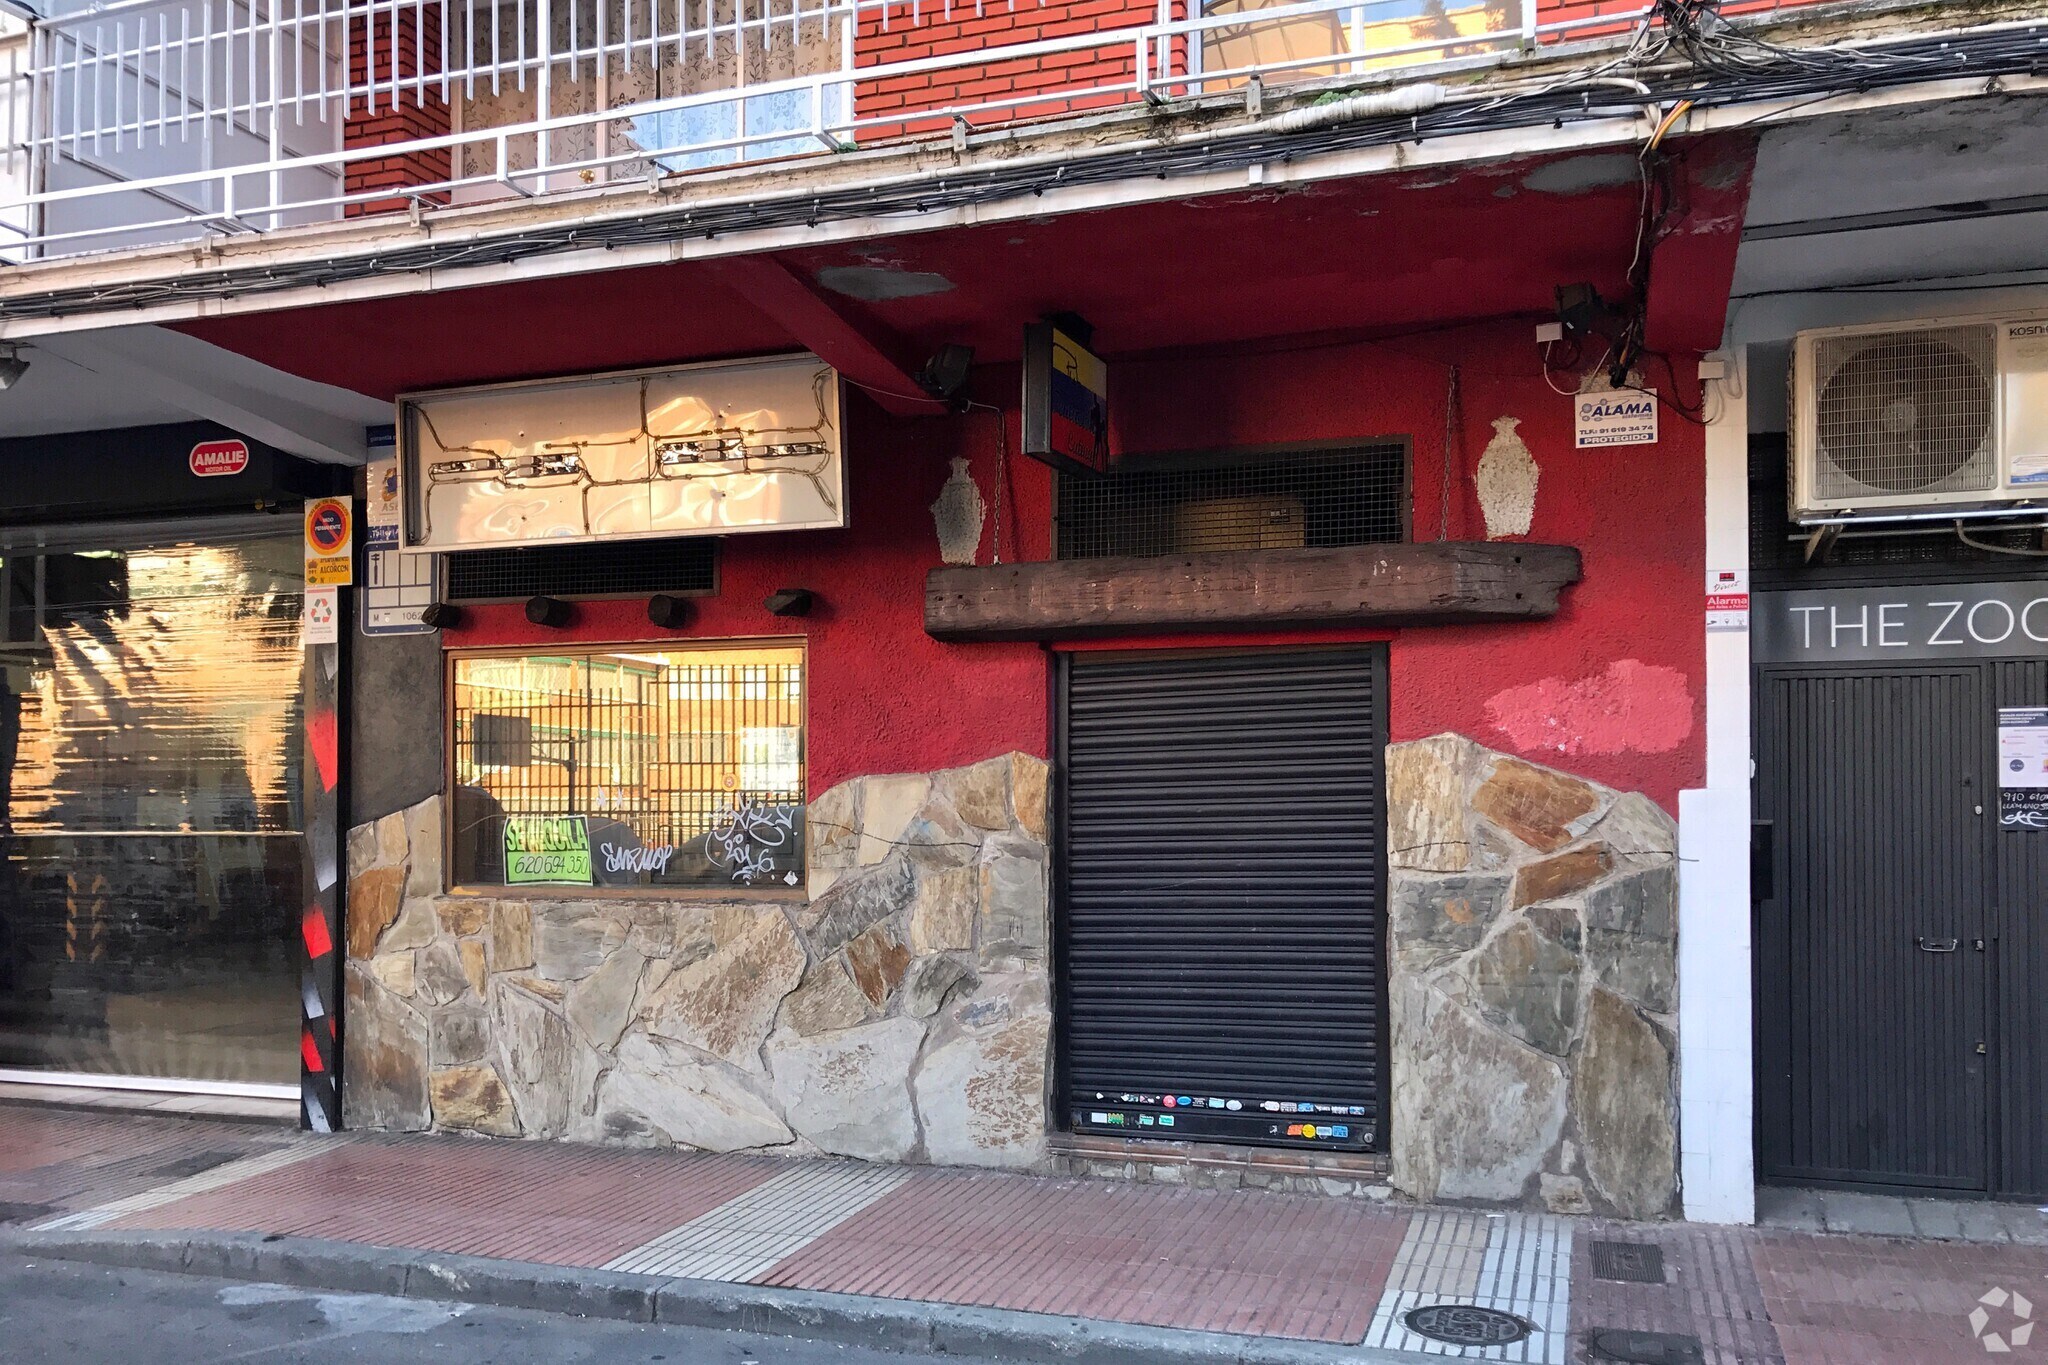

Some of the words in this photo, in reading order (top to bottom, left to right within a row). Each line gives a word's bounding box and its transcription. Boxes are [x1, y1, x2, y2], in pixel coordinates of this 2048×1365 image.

[1591, 402, 1652, 417] ALAMA
[1584, 434, 1649, 444] PROTEGIDO
[194, 450, 245, 467] AMALIE
[1707, 597, 1748, 605] Alarma
[1789, 603, 1909, 648] THE
